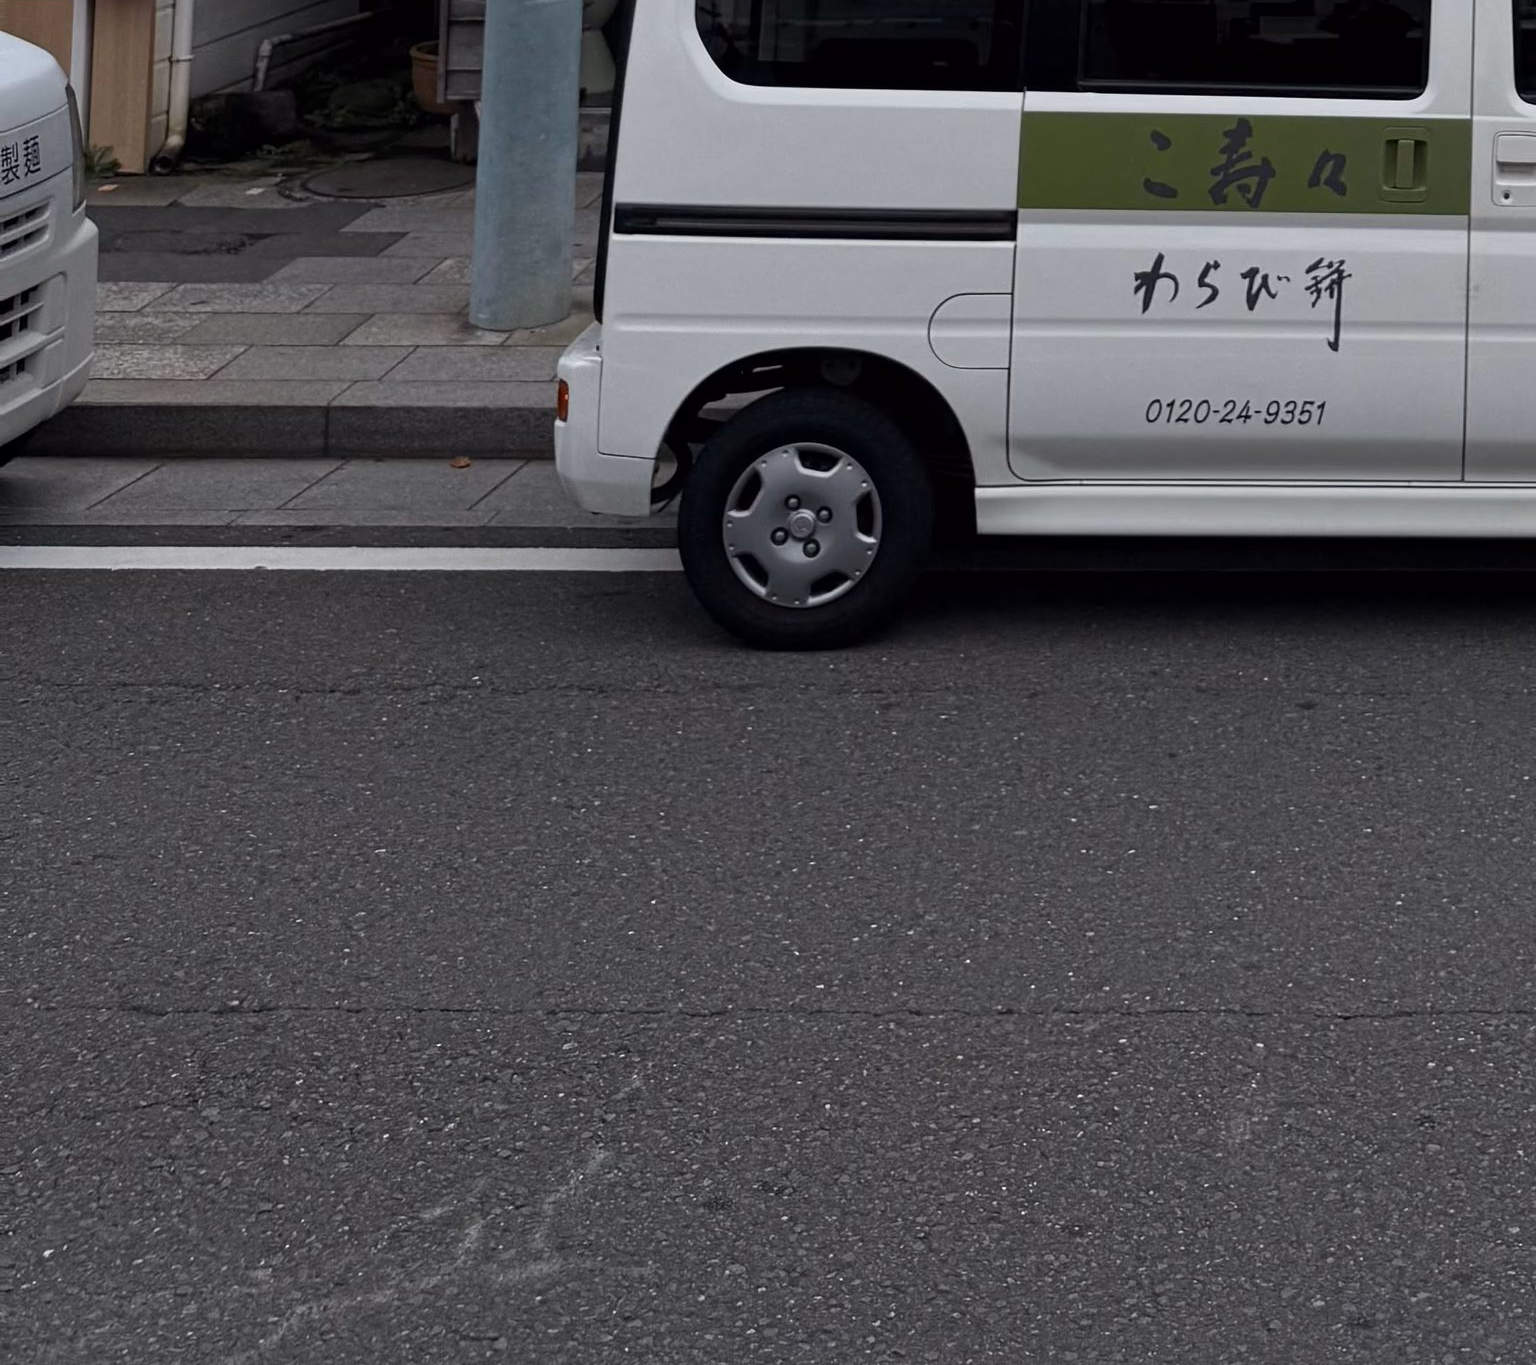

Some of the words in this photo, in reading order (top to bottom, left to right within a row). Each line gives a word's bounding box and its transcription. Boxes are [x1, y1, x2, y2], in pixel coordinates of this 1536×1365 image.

[1143, 117, 1348, 209] こ寿々
[1133, 252, 1353, 352] わらび餅
[1145, 399, 1327, 425] 0120-24-9351
